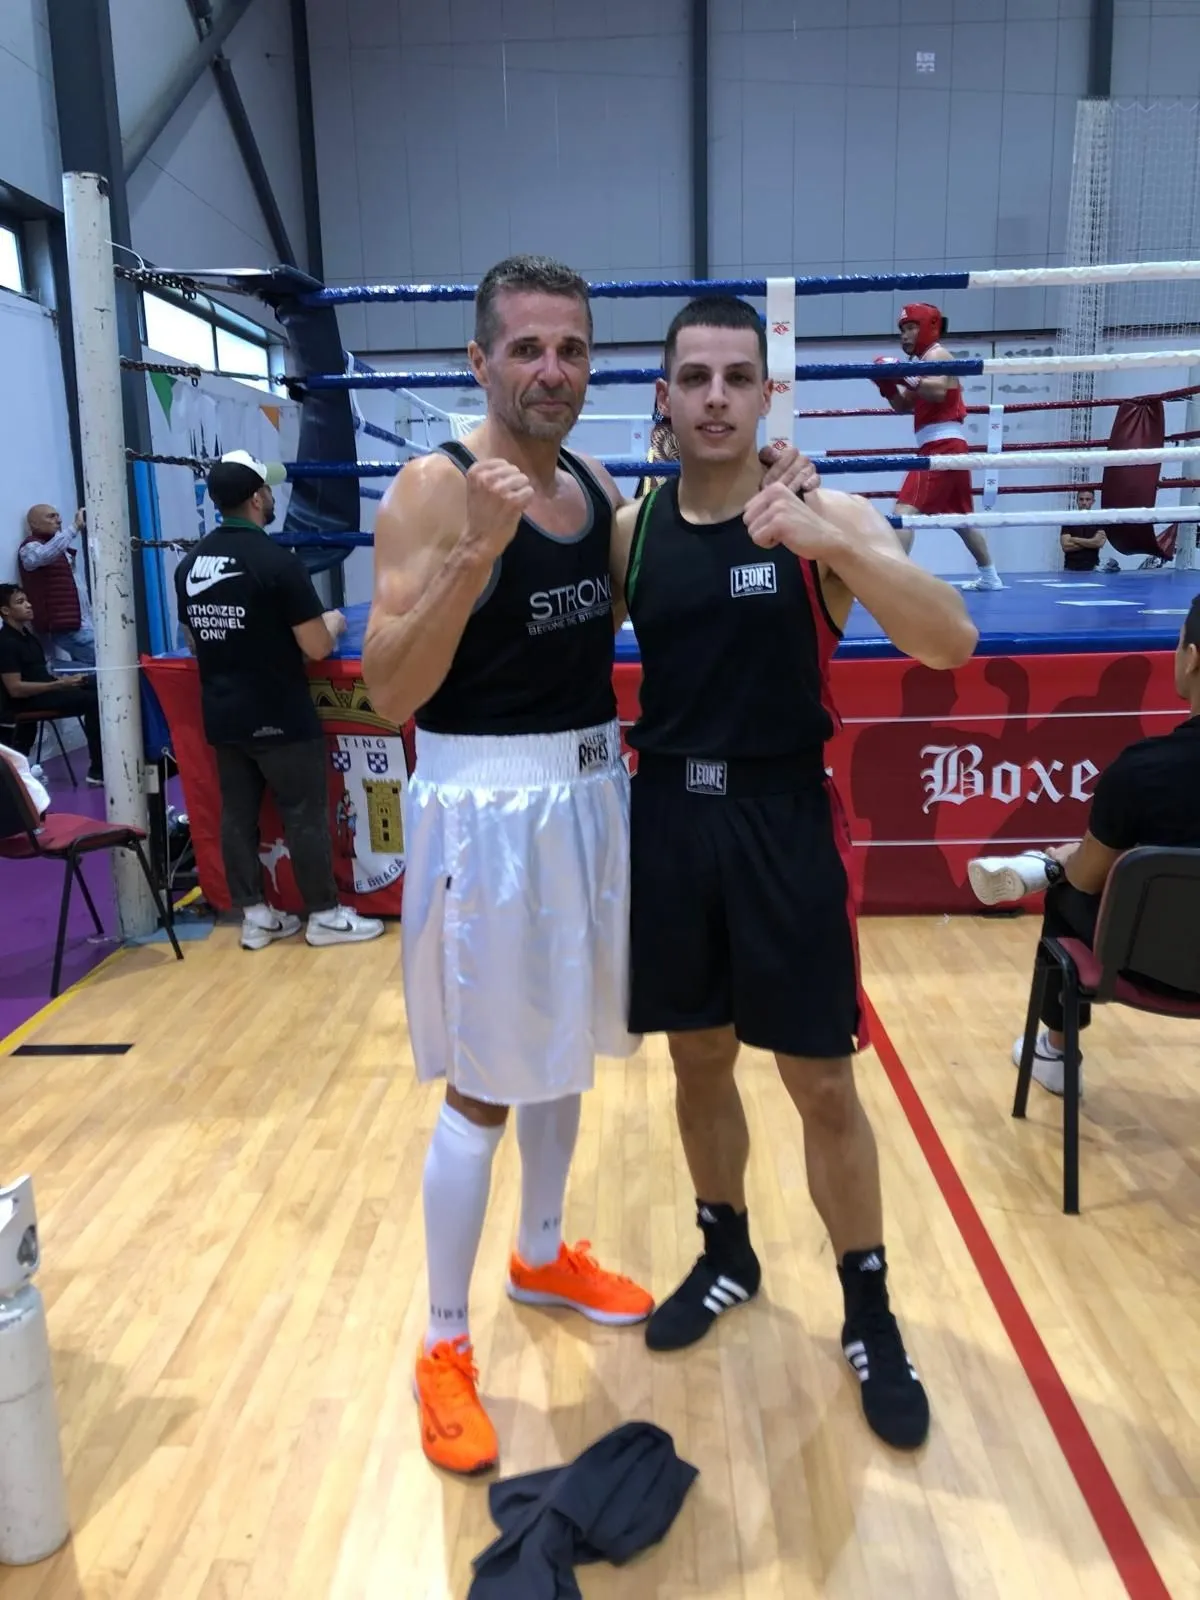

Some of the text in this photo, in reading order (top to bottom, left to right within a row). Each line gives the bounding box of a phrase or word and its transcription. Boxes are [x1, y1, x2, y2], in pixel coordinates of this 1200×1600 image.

[191, 556, 229, 578] NIKE
[735, 566, 772, 593] LEONE
[186, 604, 245, 618] UTHORIZED
[200, 629, 227, 640] ONLY
[341, 737, 386, 749] TING
[690, 762, 724, 789] LEONE
[919, 743, 1100, 815] Boxe
